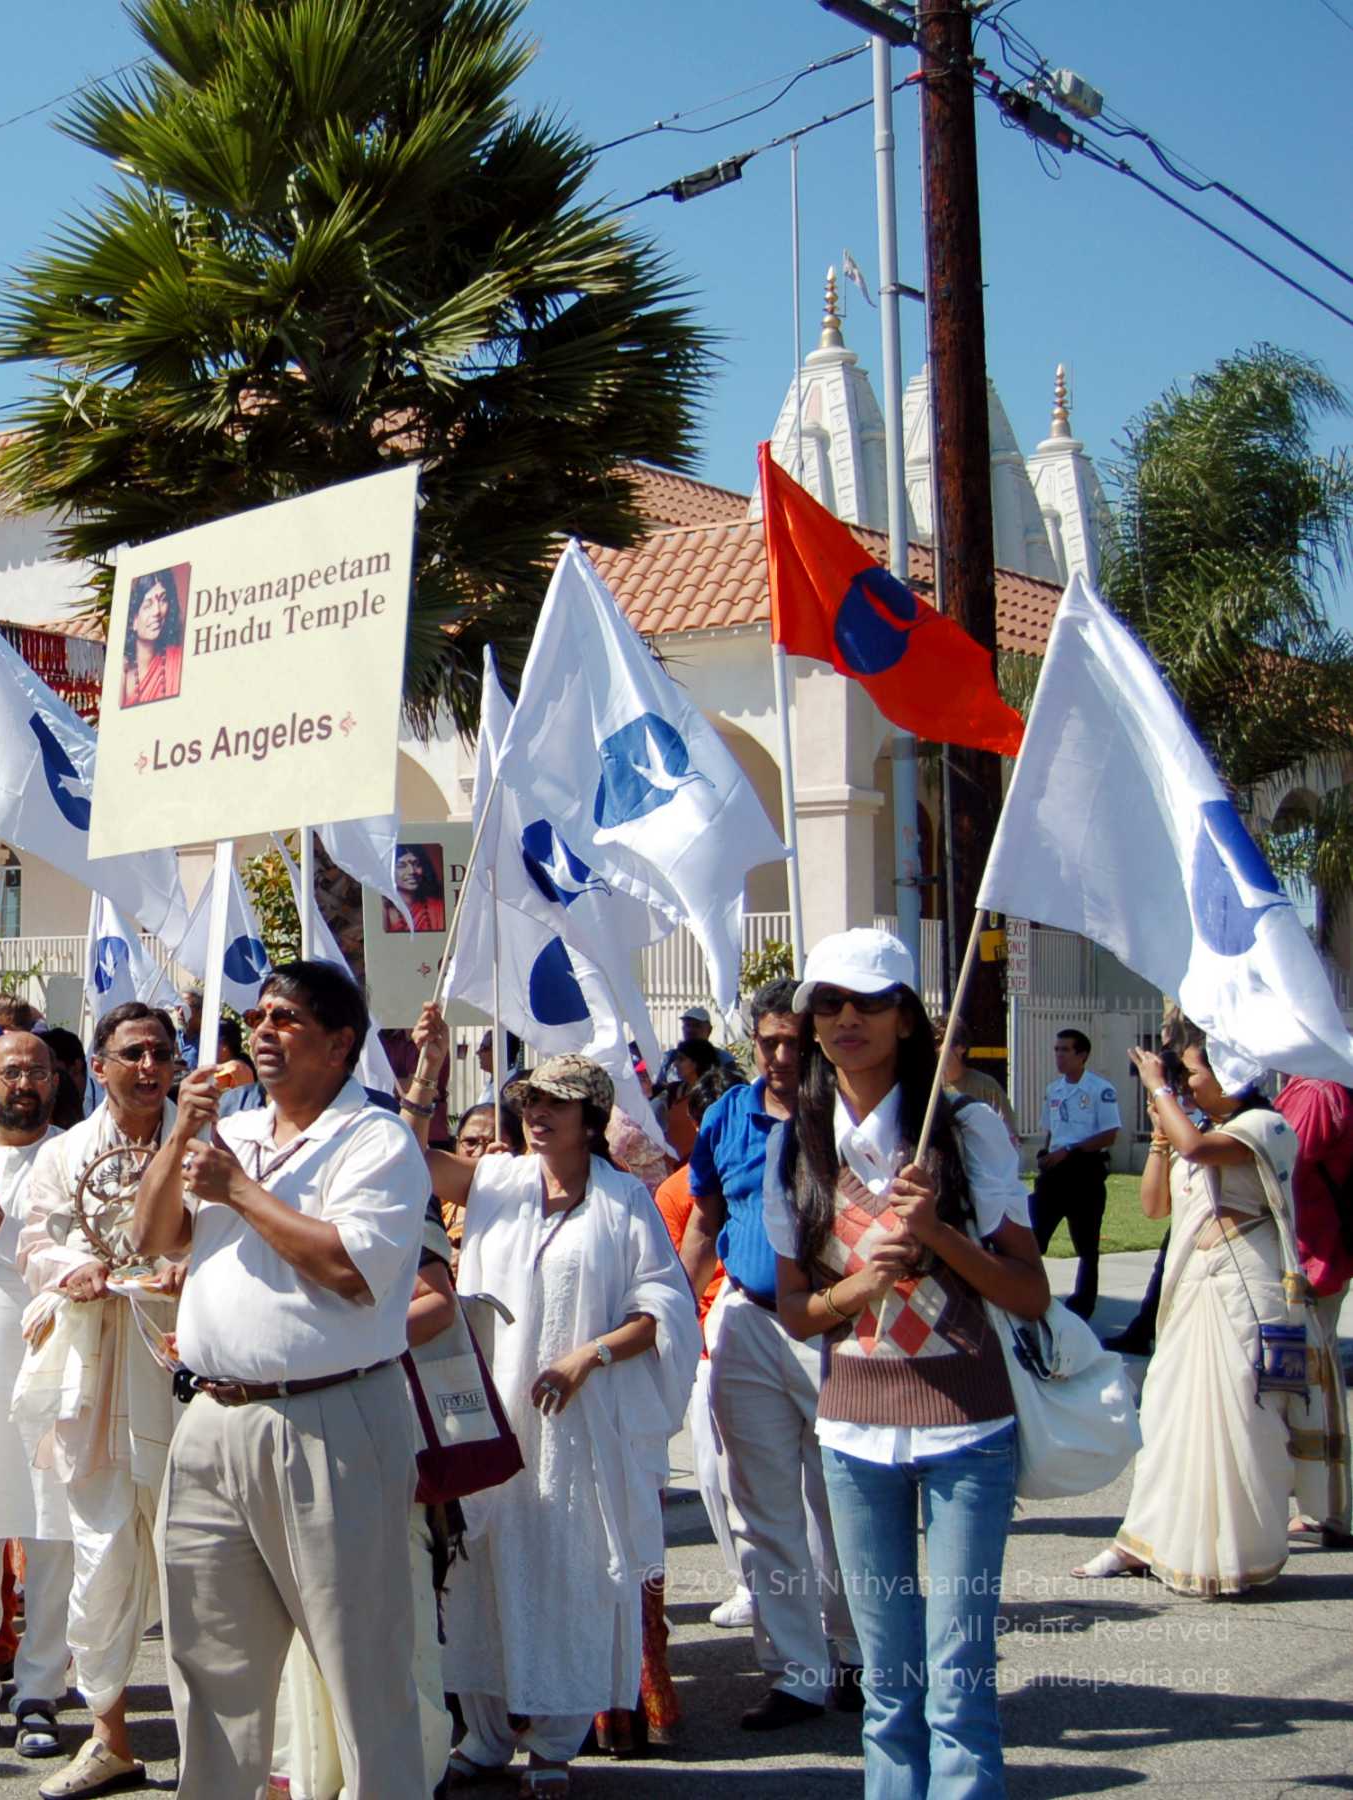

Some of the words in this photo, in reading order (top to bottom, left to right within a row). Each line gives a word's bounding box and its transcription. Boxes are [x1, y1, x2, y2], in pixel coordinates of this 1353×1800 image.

[194, 551, 391, 618] Dhyanapeetam
[192, 616, 272, 656] Hindu
[283, 589, 386, 635] Temple
[153, 739, 202, 771] Los
[210, 712, 333, 761] Angeles
[1006, 920, 1028, 937] EXIT
[1007, 940, 1028, 956] ONLY
